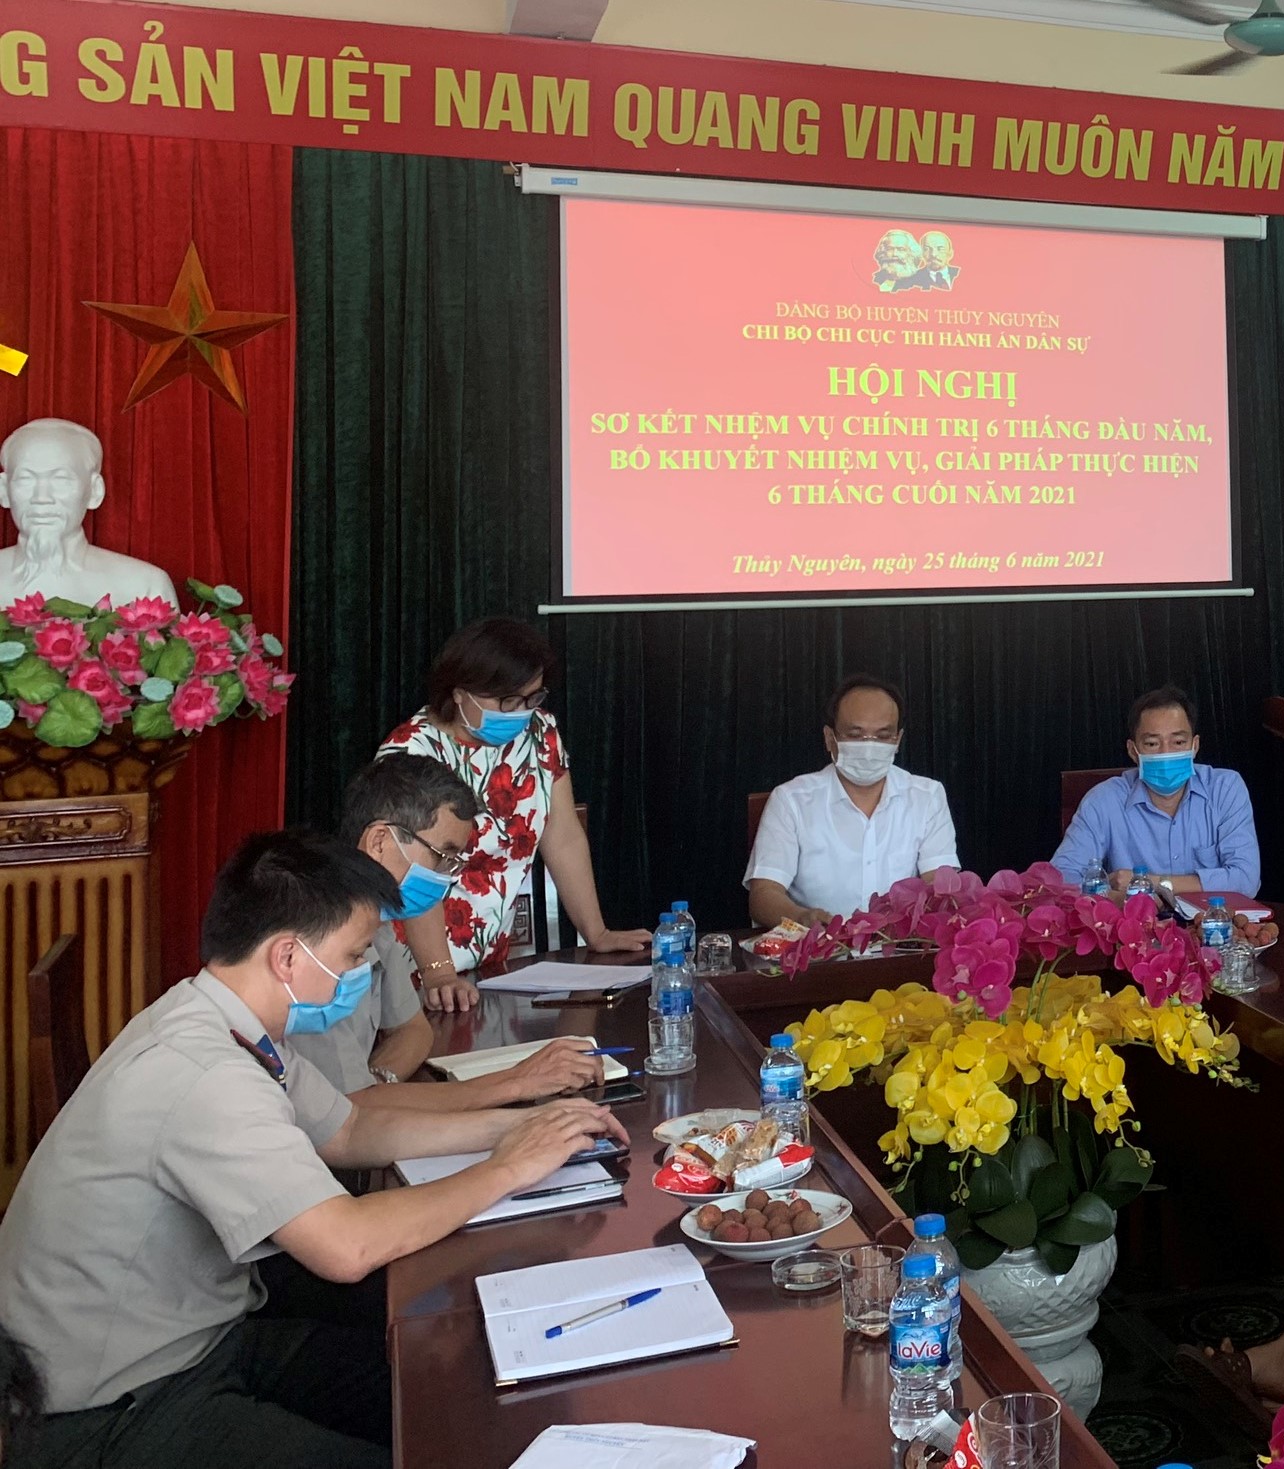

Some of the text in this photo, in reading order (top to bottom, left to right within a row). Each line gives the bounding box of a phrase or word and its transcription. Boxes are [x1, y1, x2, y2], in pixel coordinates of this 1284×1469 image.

[0, 20, 1284, 191] G SẢN VIỆT NAM QUANG VINH MUÔN NĂM
[836, 303, 862, 322] BỘ
[866, 306, 929, 324] HUYỆN
[988, 311, 1060, 328] NGUYÊN
[742, 324, 1092, 354] CHI BỘ CHI CỤC THI HÀNH ÁN DÂN SỰ
[827, 363, 1018, 408] HỘI NGHỊ
[591, 412, 630, 434] SƠ
[637, 408, 698, 434] KẾT
[797, 415, 835, 440] VỤ
[842, 411, 928, 436] CHÍNH
[935, 417, 979, 443] TRỊ
[986, 419, 999, 438] 6
[1003, 414, 1091, 439] THÁNG
[1097, 416, 1147, 441] ĐẦU
[1153, 418, 1213, 446] NĂM,
[610, 443, 1199, 479] BỔ KHUYẾT NHIỆM VỤ, GIẢI PHÁP THỰC HIỆN
[768, 479, 1076, 505] 6 THÁNG CUỐI NĂM 2021
[732, 551, 1105, 578] Thủy Nguyên, ngày 25 tháng 6 năm 2021
